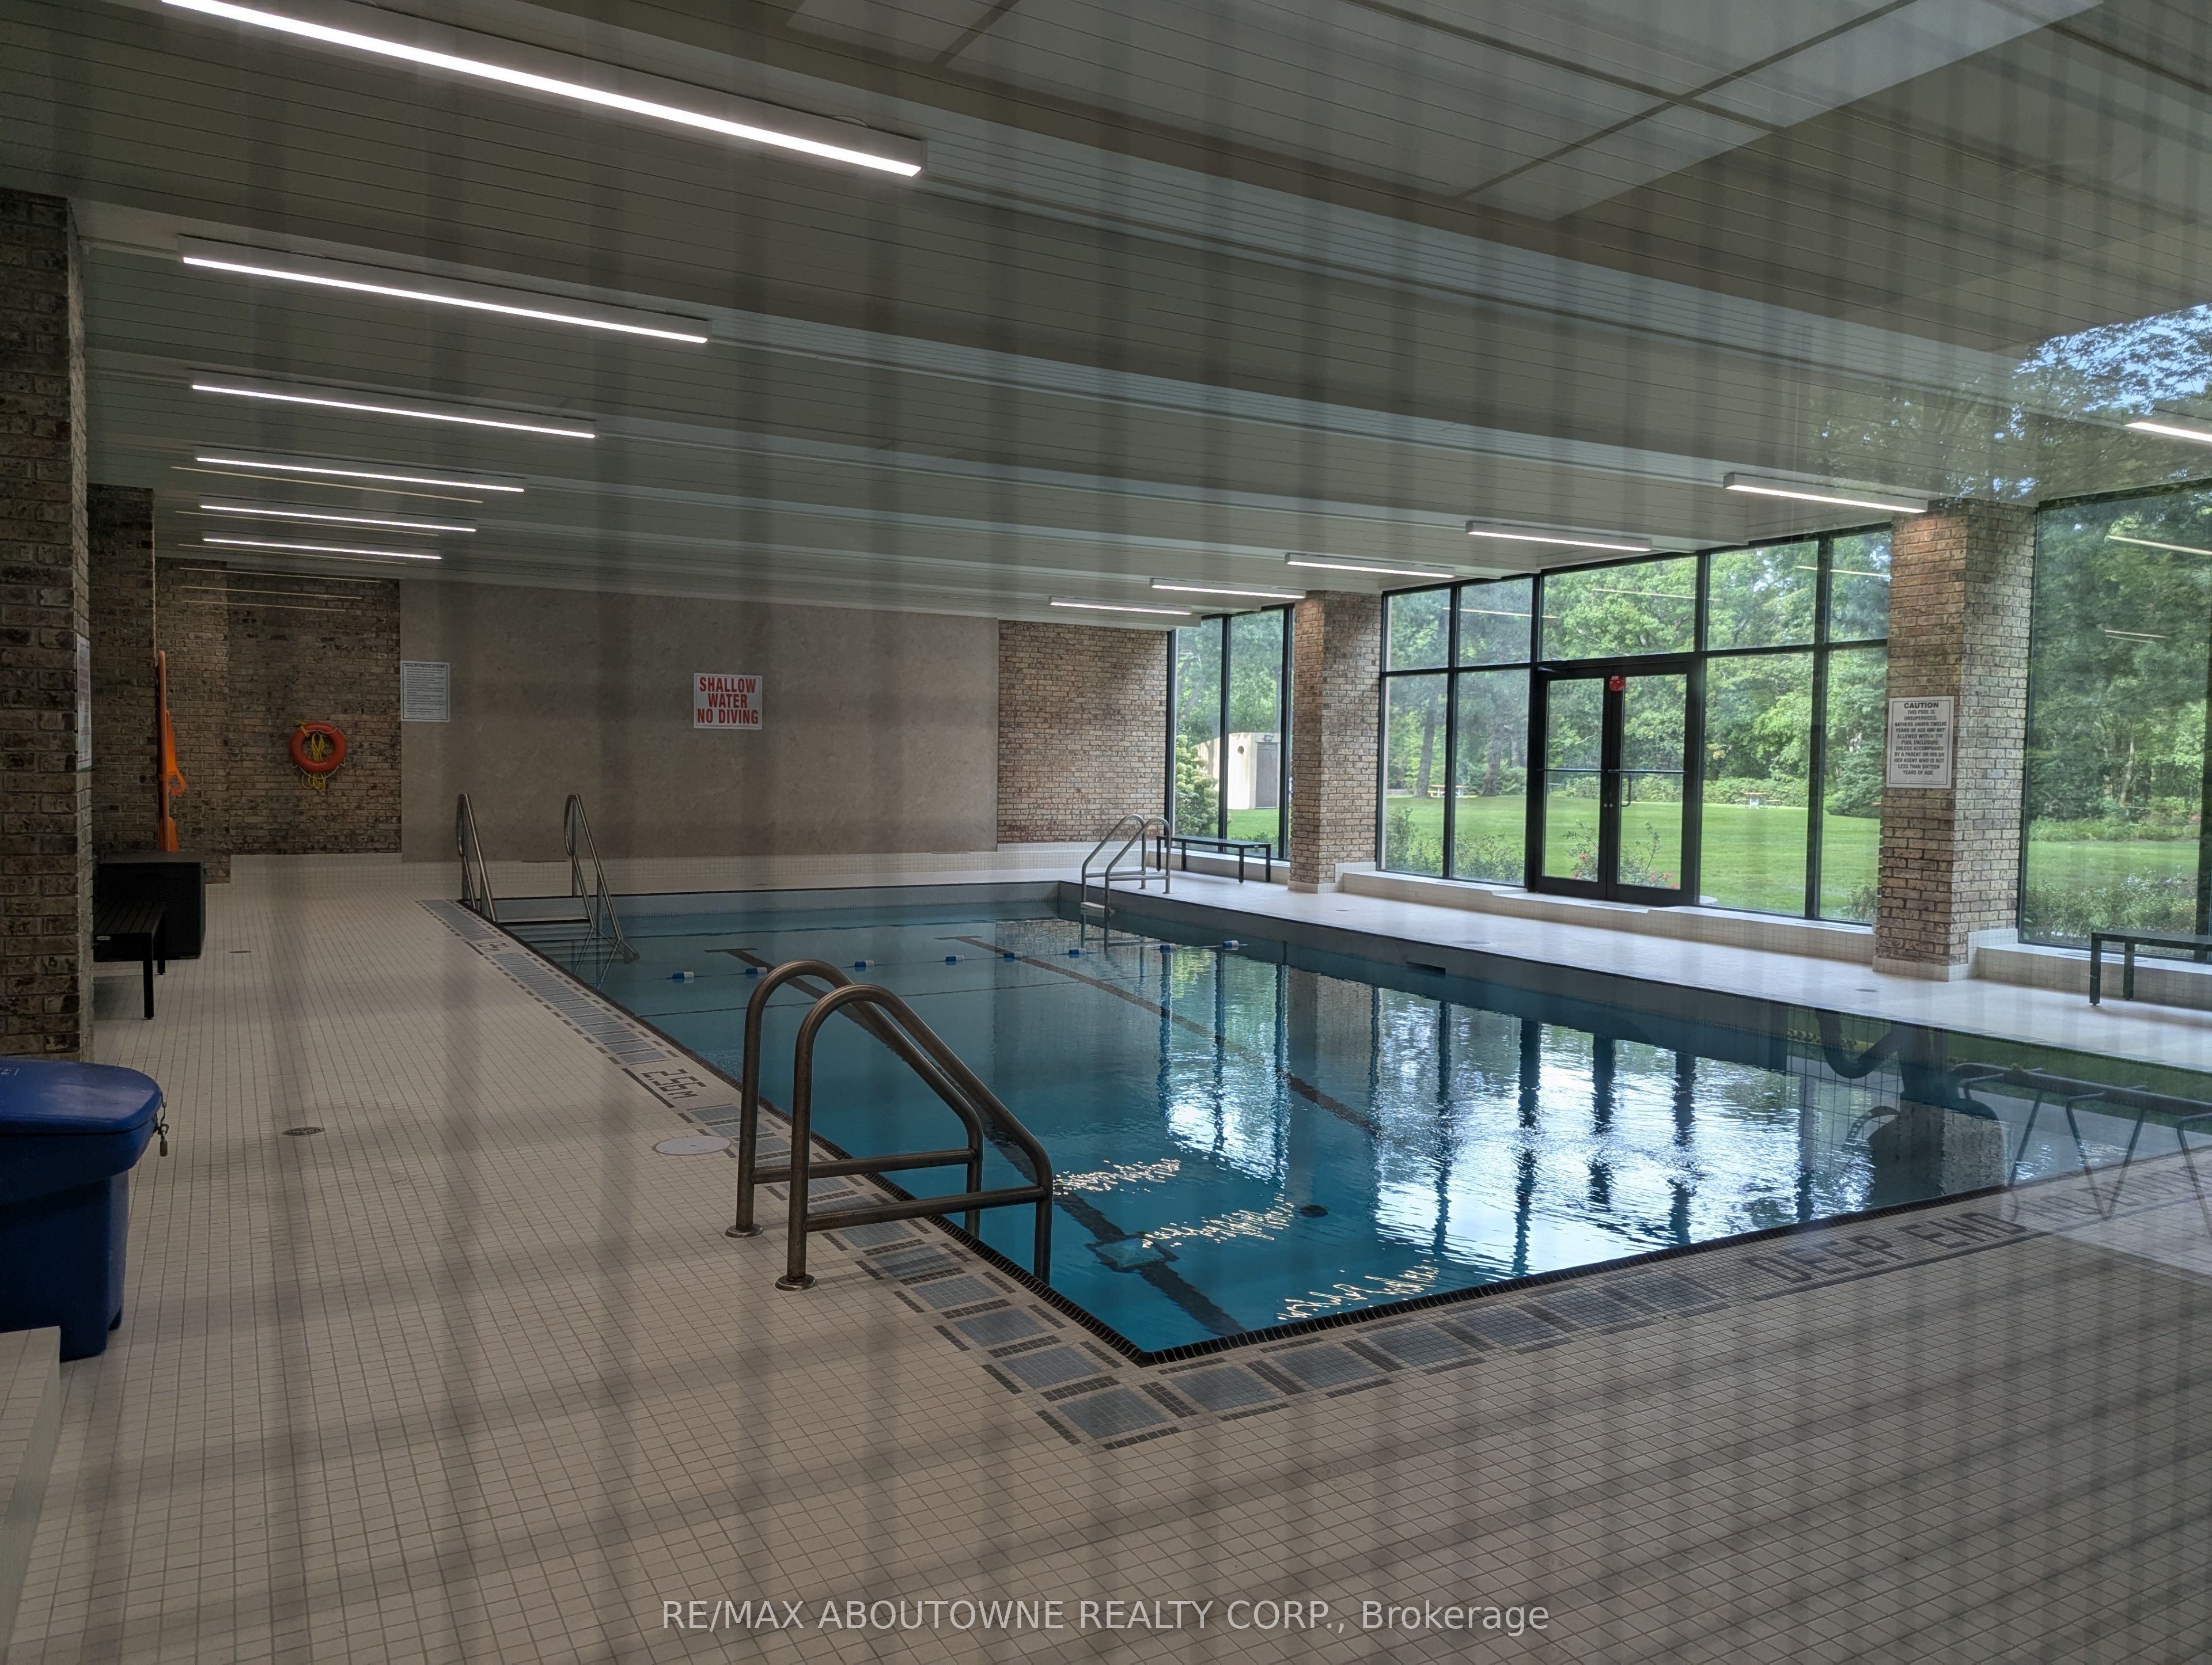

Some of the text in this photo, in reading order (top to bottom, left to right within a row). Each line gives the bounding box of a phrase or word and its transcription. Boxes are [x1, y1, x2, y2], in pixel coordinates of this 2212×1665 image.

[700, 677, 756, 693] SHALLOW
[708, 693, 747, 708] WATER
[698, 708, 759, 724] NO DIVING
[1743, 1235, 1904, 1284] DEEP
[1897, 1212, 2027, 1249] END
